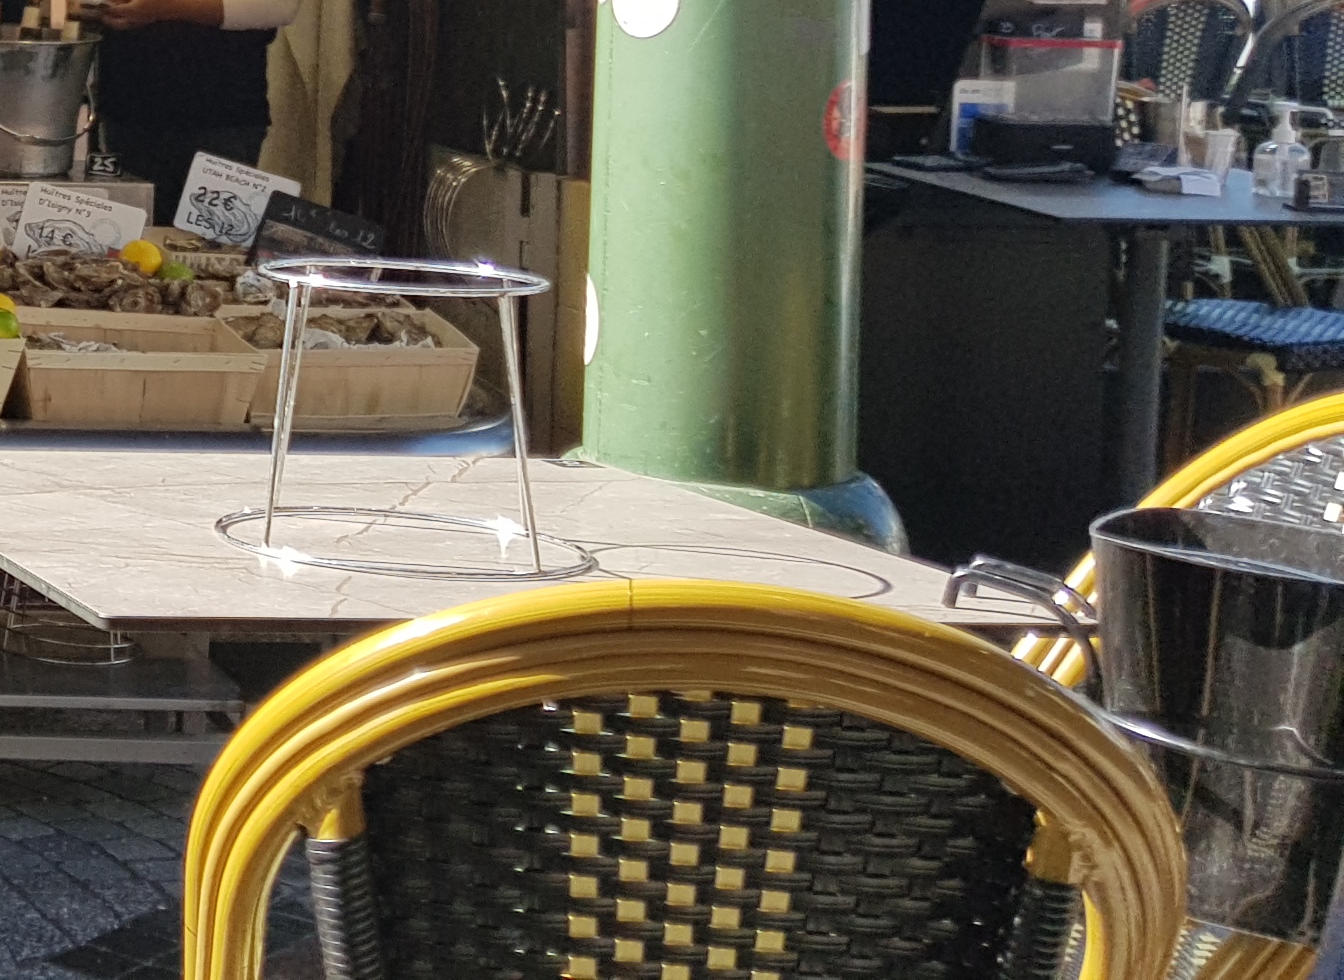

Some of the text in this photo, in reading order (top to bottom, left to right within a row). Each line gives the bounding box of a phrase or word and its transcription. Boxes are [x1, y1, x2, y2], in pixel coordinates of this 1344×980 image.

[92, 157, 116, 171] 25
[206, 157, 233, 171] Huîtres
[202, 166, 223, 180] UTAH
[225, 172, 250, 187] BEACH
[1, 188, 27, 196] Huître
[40, 187, 113, 212] Huîtres Spéciales
[196, 186, 238, 212] 22 €
[186, 211, 235, 236] LES 12
[38, 225, 74, 247] 14 €
